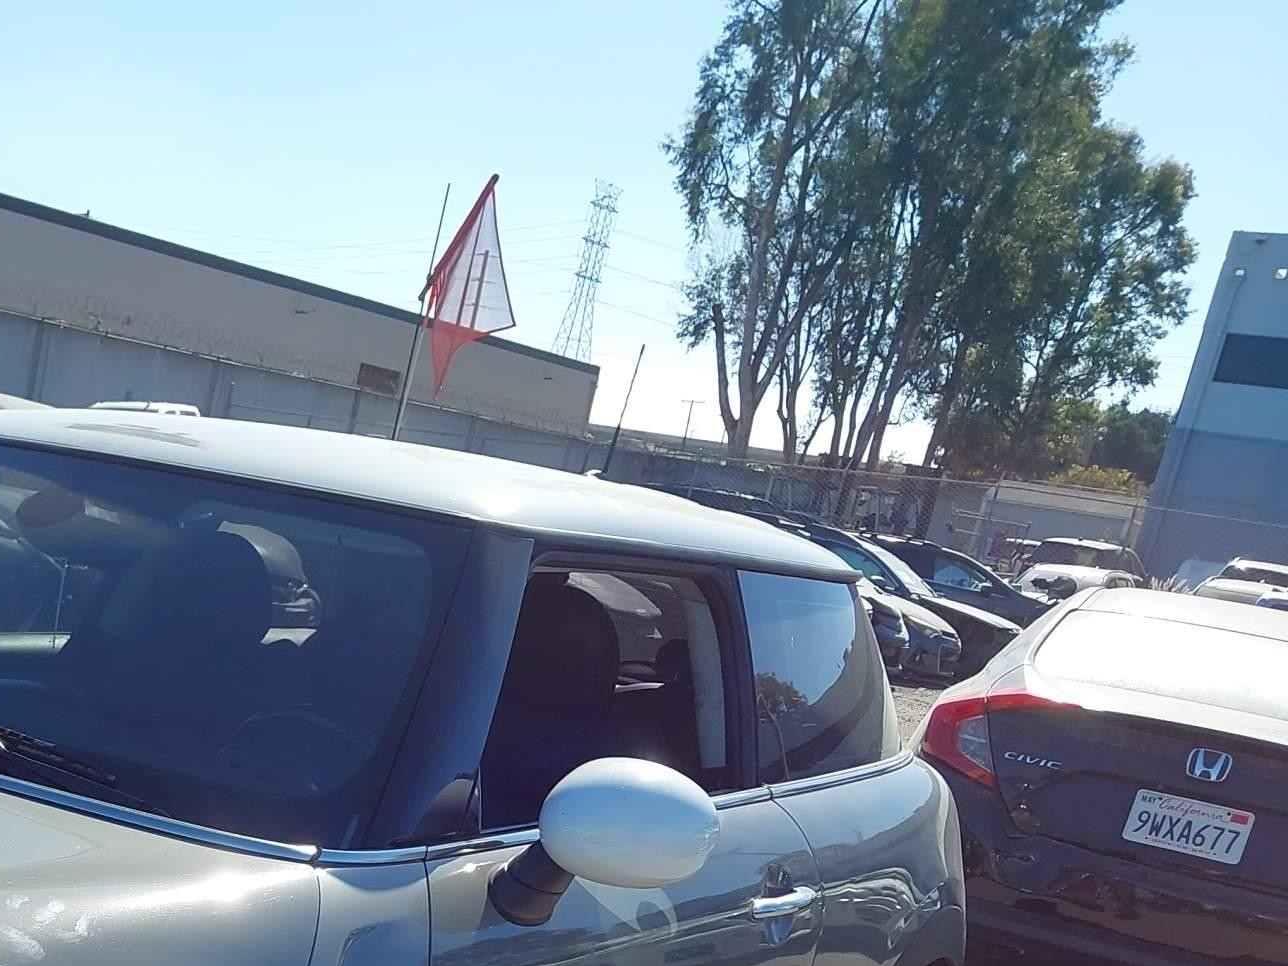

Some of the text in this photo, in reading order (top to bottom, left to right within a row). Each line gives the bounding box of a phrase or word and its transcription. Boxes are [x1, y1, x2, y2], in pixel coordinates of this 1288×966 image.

[1003, 750, 1062, 770] CIVIC
[1141, 794, 1157, 803] MAY
[1158, 798, 1230, 823] California
[1132, 810, 1241, 854] 9WXA677
